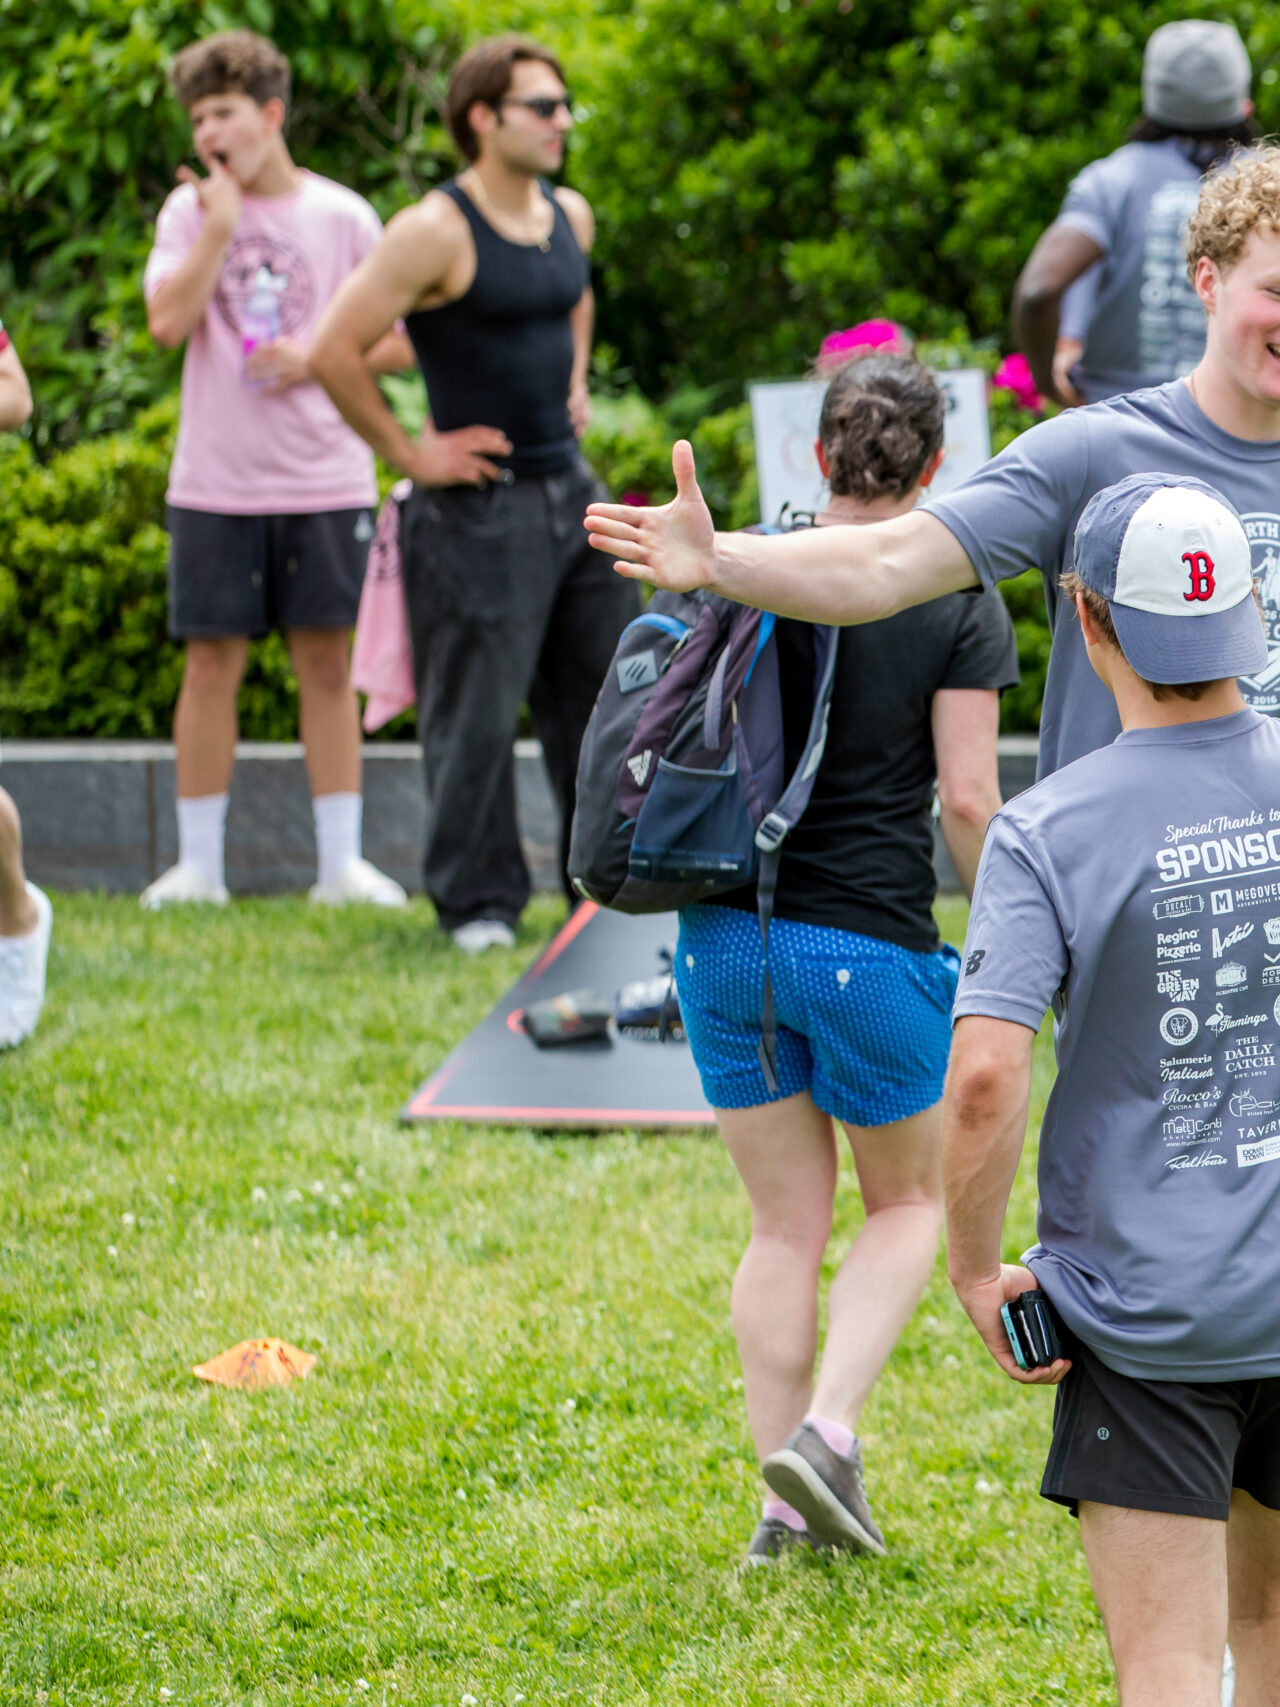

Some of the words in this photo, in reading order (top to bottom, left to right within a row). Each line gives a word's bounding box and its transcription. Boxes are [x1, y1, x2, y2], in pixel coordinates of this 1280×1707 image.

[1245, 521, 1280, 541] RTH
[1182, 551, 1216, 602] B
[1252, 694, 1278, 706] 2016
[1164, 818, 1214, 845] Special
[1213, 809, 1265, 834] Thanks
[1157, 928, 1199, 946] Regina
[1156, 941, 1202, 959] Pizzeria
[1156, 969, 1182, 983] THE
[1156, 978, 1200, 994] GREEN
[1168, 989, 1198, 1003] WAY
[1219, 1013, 1269, 1032] Flamingo
[1235, 1035, 1259, 1046] THE
[1223, 1043, 1274, 1062] DAILY
[1159, 1054, 1213, 1069] Salumeria
[1225, 1055, 1276, 1073] CATCH
[1160, 1066, 1215, 1083] Italiana
[1161, 1085, 1224, 1105] Rocco's
[1194, 1101, 1202, 1109] &
[1195, 1117, 1223, 1133] Conti
[1242, 1145, 1265, 1156] DOWN
[1243, 1152, 1265, 1162] TOWN
